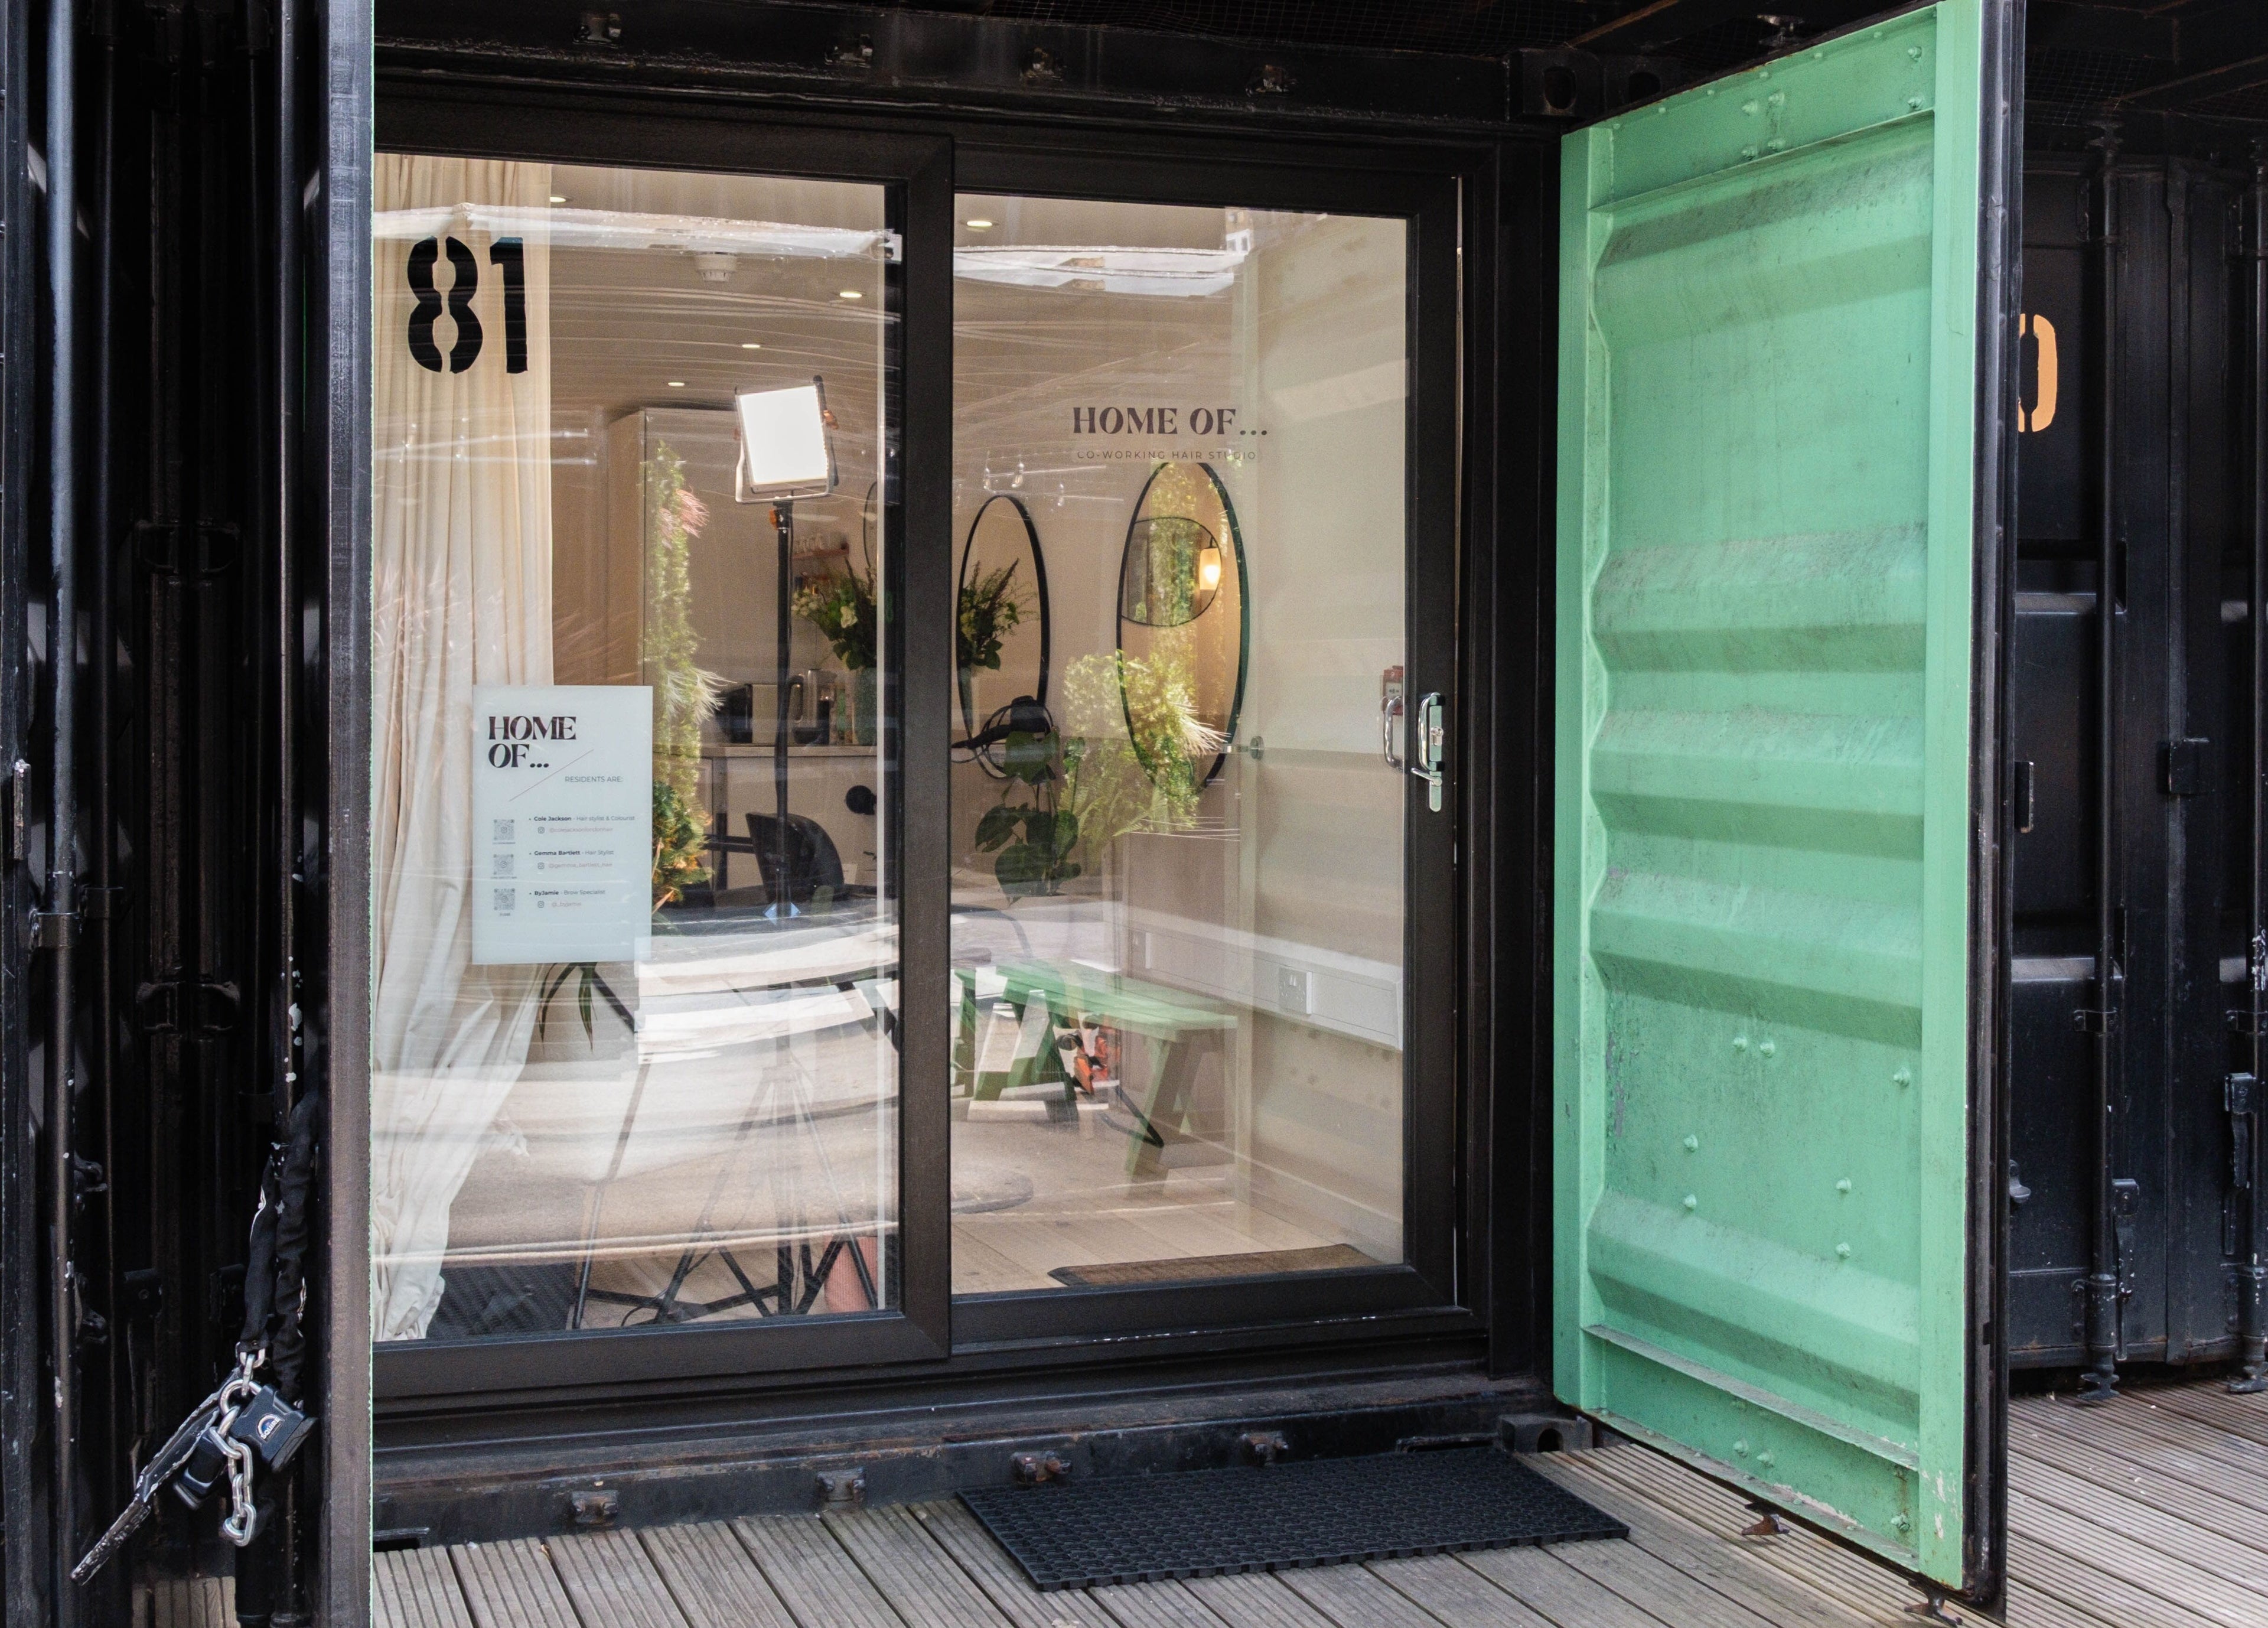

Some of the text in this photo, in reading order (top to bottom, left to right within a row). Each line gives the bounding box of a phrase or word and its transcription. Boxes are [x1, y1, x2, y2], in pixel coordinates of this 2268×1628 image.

[407, 236, 529, 374] 81
[1073, 406, 1267, 435] HOME OF...
[1077, 451, 1256, 460] CO-WORKING HAIR STUDIO
[488, 715, 576, 740] HOME
[488, 743, 549, 768] OF...
[260, 1417, 281, 1439] SQUIRE
